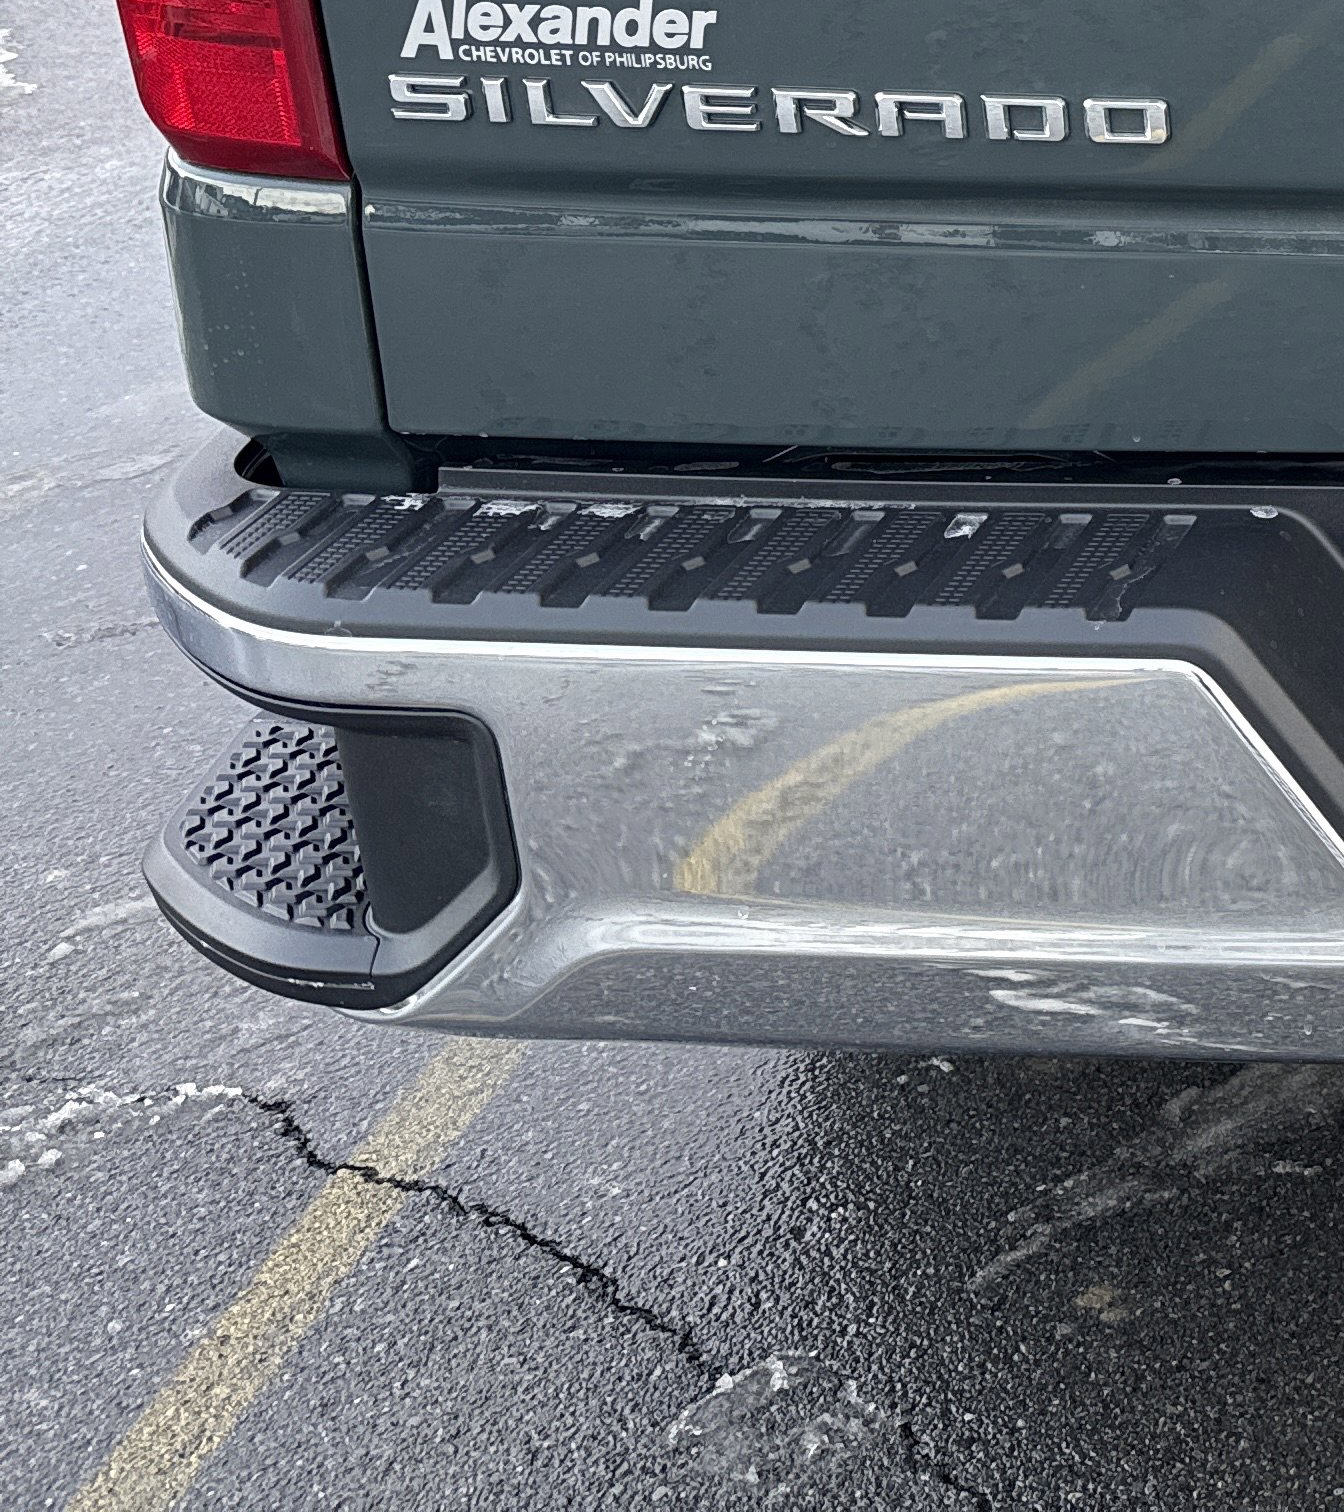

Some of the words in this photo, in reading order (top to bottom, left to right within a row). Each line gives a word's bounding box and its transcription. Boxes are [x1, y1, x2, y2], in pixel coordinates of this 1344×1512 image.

[458, 44, 574, 66] CHEVROLET
[578, 51, 601, 66] OF
[604, 52, 712, 71] PHILIPSBURG
[388, 73, 1172, 145] SILVERADO
